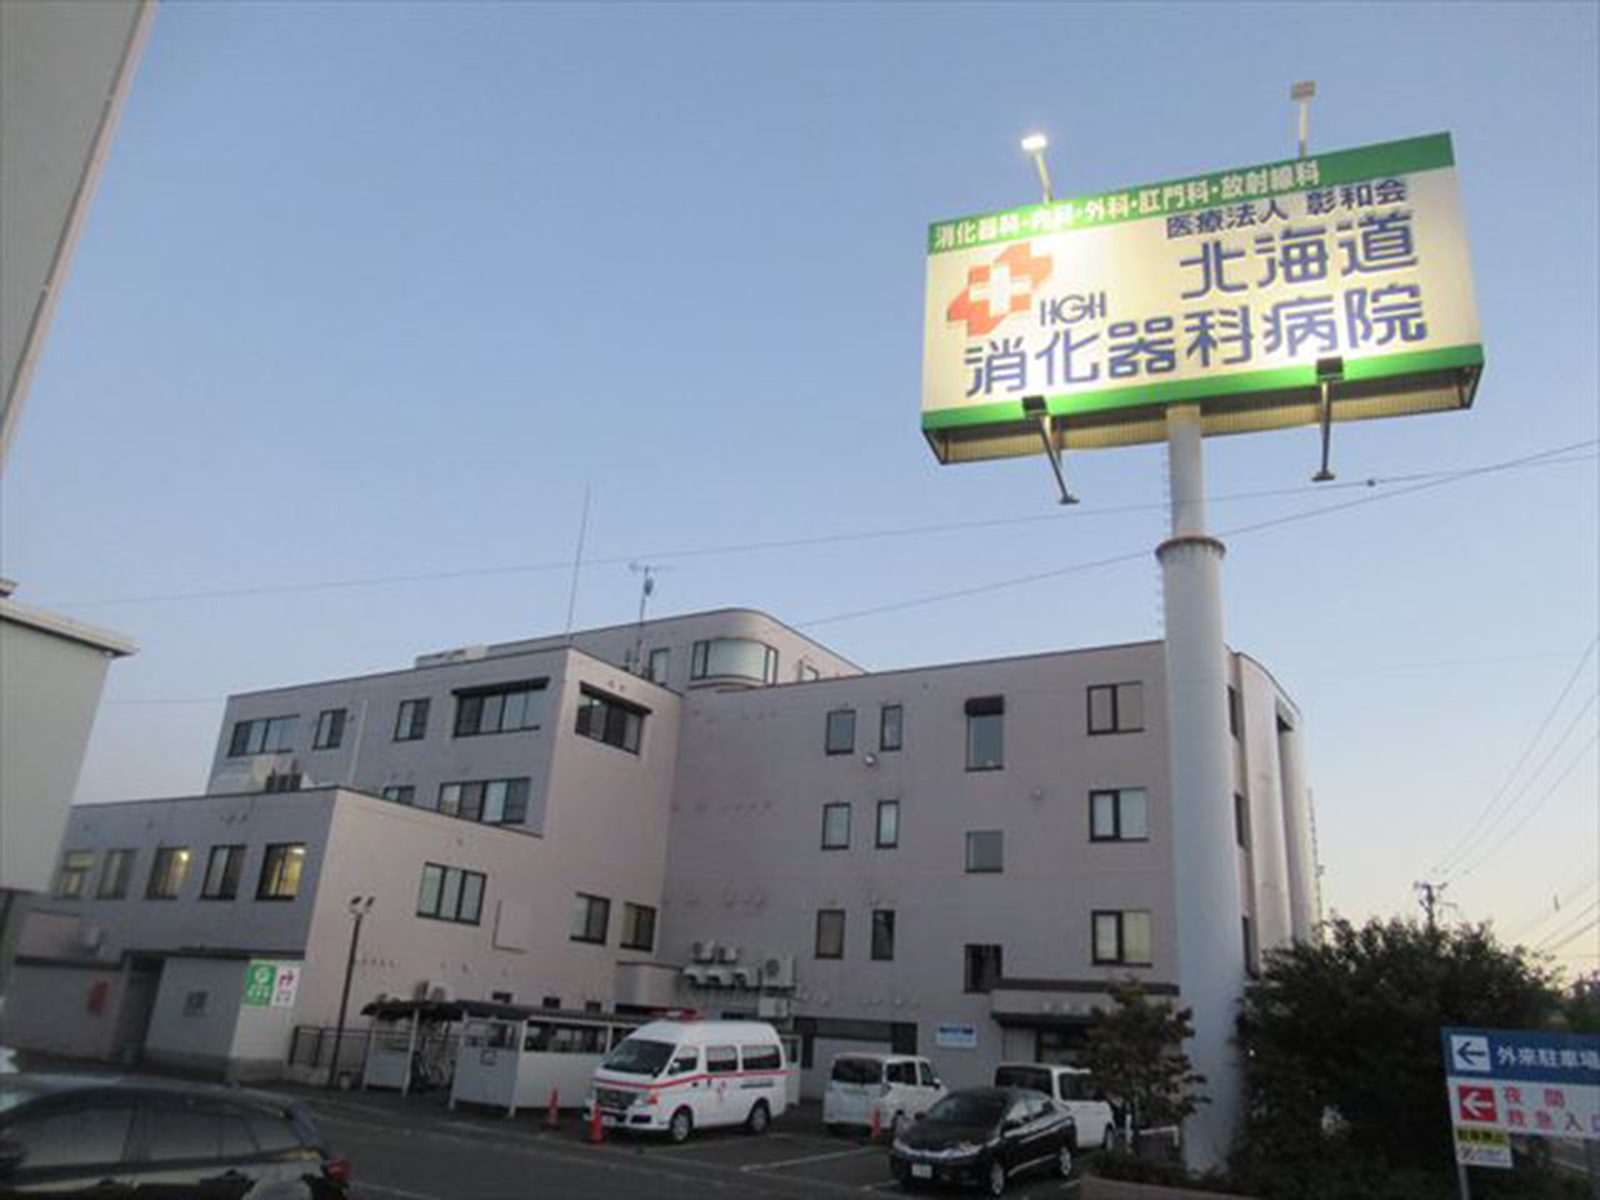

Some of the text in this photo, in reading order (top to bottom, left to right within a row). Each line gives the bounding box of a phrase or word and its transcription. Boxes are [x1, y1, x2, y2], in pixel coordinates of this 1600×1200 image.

[1166, 178, 1407, 240] 医療法人 彰和会
[1179, 211, 1418, 300] 北海道
[964, 282, 1428, 398] 消化器科病院
